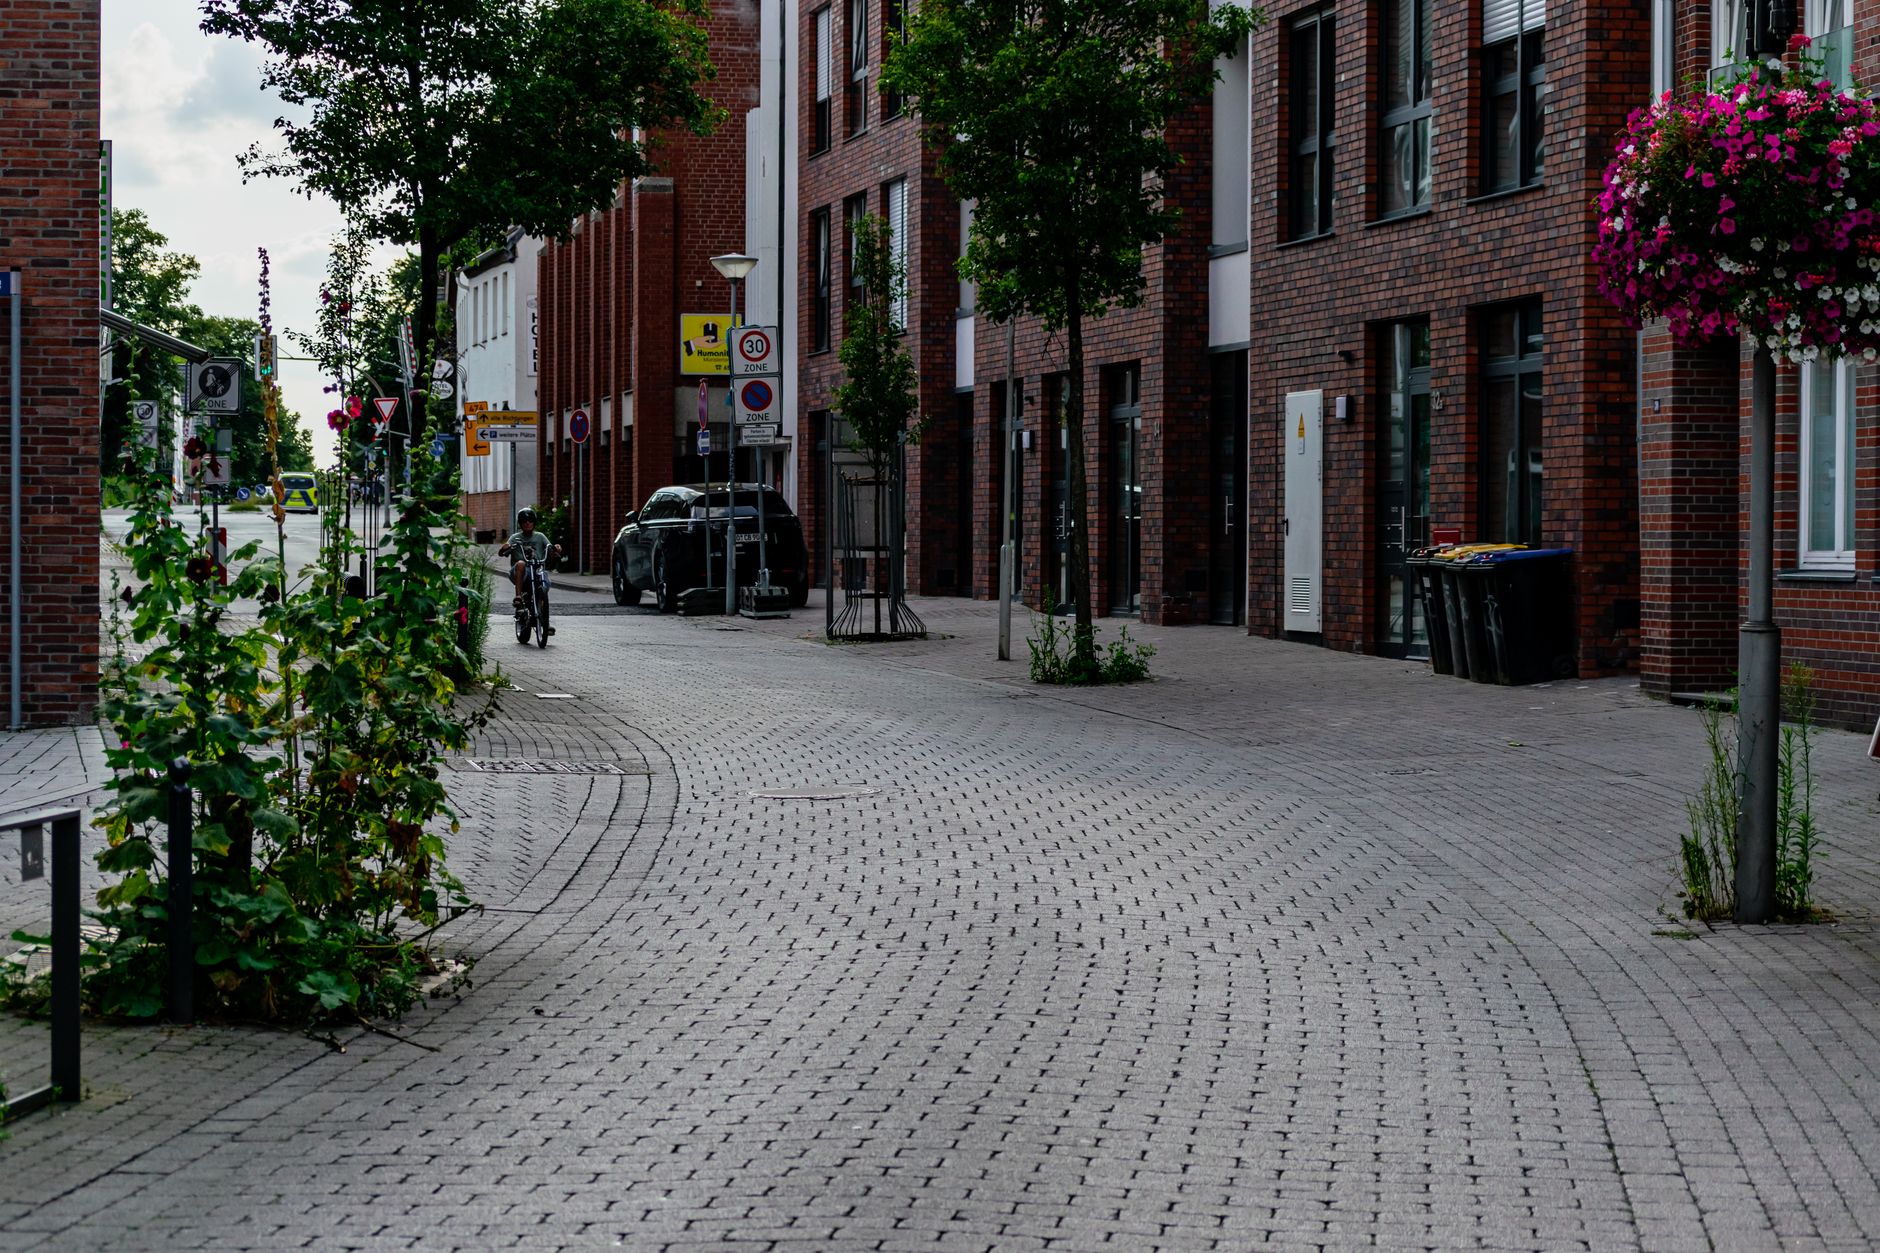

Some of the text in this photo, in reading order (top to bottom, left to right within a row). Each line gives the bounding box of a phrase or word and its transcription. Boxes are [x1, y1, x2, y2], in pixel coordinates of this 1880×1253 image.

[745, 339, 764, 354] 30
[744, 363, 768, 372] ZONE
[206, 399, 227, 408] ONE
[746, 412, 770, 422] ZONE
